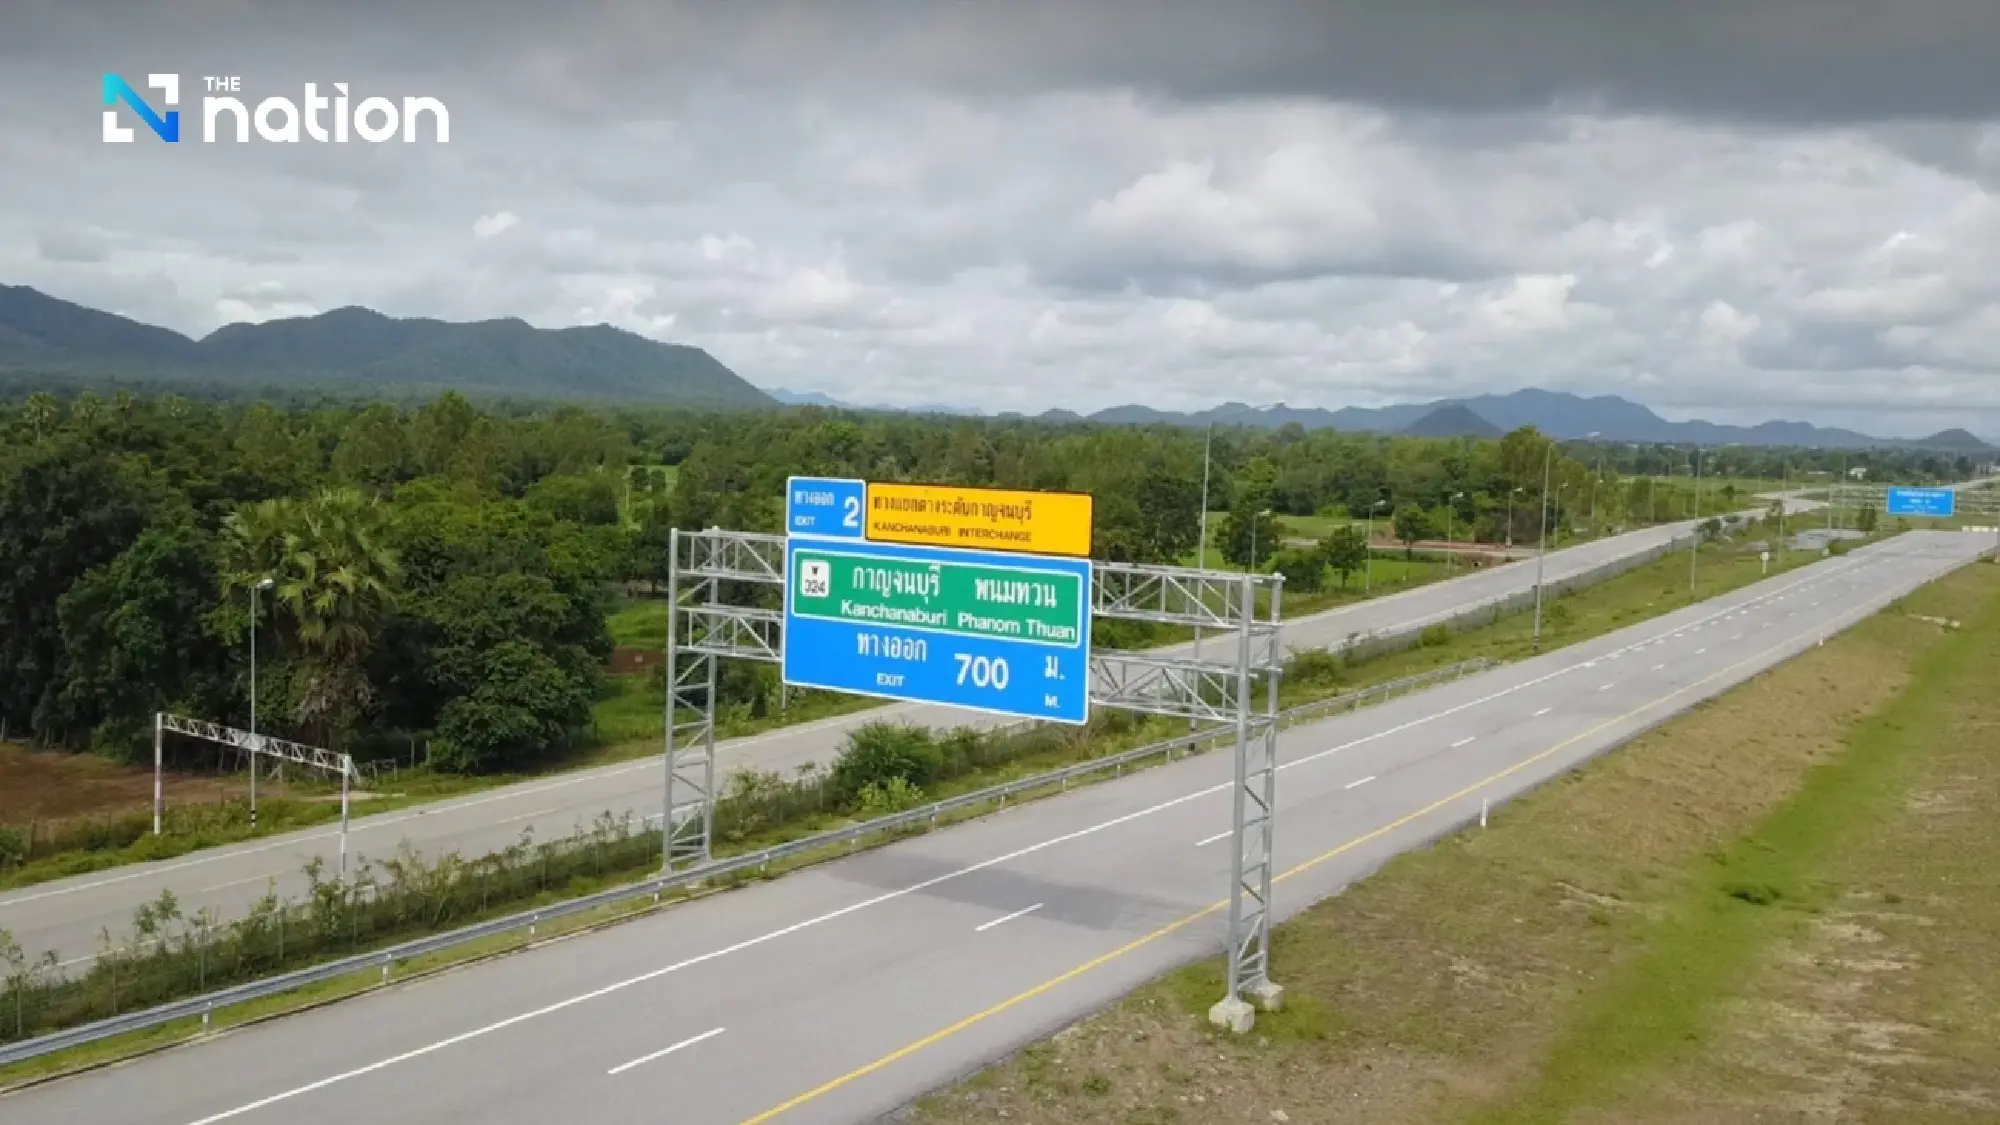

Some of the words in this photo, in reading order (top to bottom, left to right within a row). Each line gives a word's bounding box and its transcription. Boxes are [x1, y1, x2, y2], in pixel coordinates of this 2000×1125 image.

[794, 490, 835, 506] ทางออก
[794, 515, 816, 526] EXIT
[843, 496, 859, 528] 2
[873, 521, 952, 536] KANCHANABURI
[958, 527, 1033, 542] INTERCHANGE
[804, 579, 826, 594] 324
[851, 563, 940, 605] กาญจนบุรี
[974, 577, 1058, 608] พนมทวน
[841, 599, 948, 626] Kanchanaburi
[957, 611, 1020, 634] Phanom
[1026, 618, 1075, 640] Thuan
[857, 632, 927, 661] ทางออก
[954, 652, 1009, 690] 700
[1044, 655, 1065, 680] ม.
[876, 672, 905, 687] EXIT
[1044, 693, 1060, 708] M.
